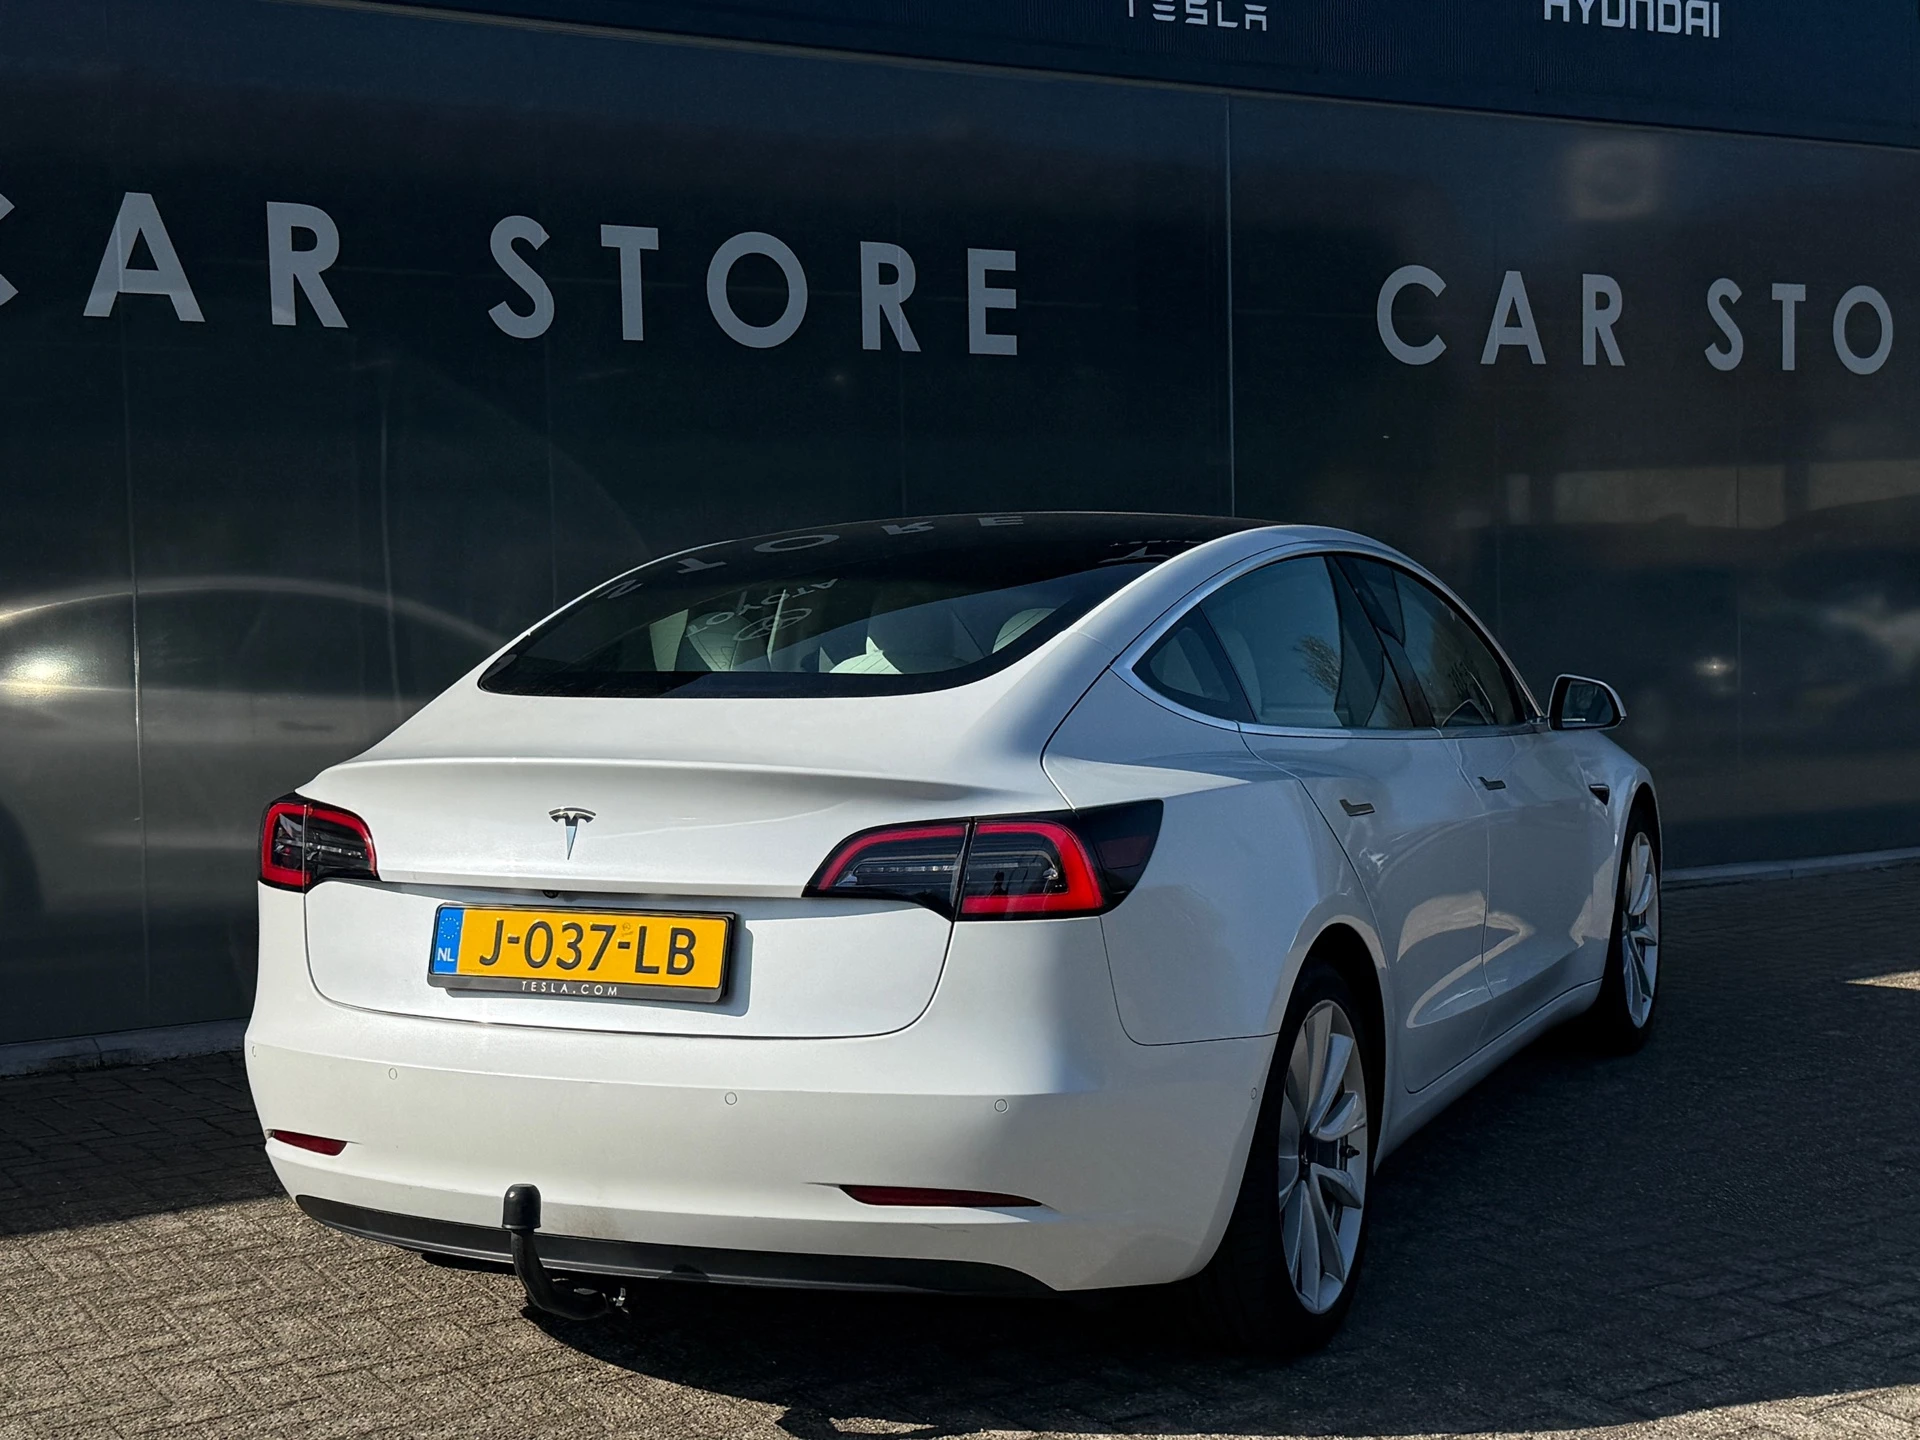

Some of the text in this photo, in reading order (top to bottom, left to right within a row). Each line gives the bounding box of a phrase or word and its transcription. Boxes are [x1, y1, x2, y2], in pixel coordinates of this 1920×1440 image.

[0, 192, 1018, 355] AR STORE
[1377, 265, 1894, 375] CAR STO
[437, 918, 697, 976] NL J-037-LB
[521, 980, 618, 996] TESLA.COM
